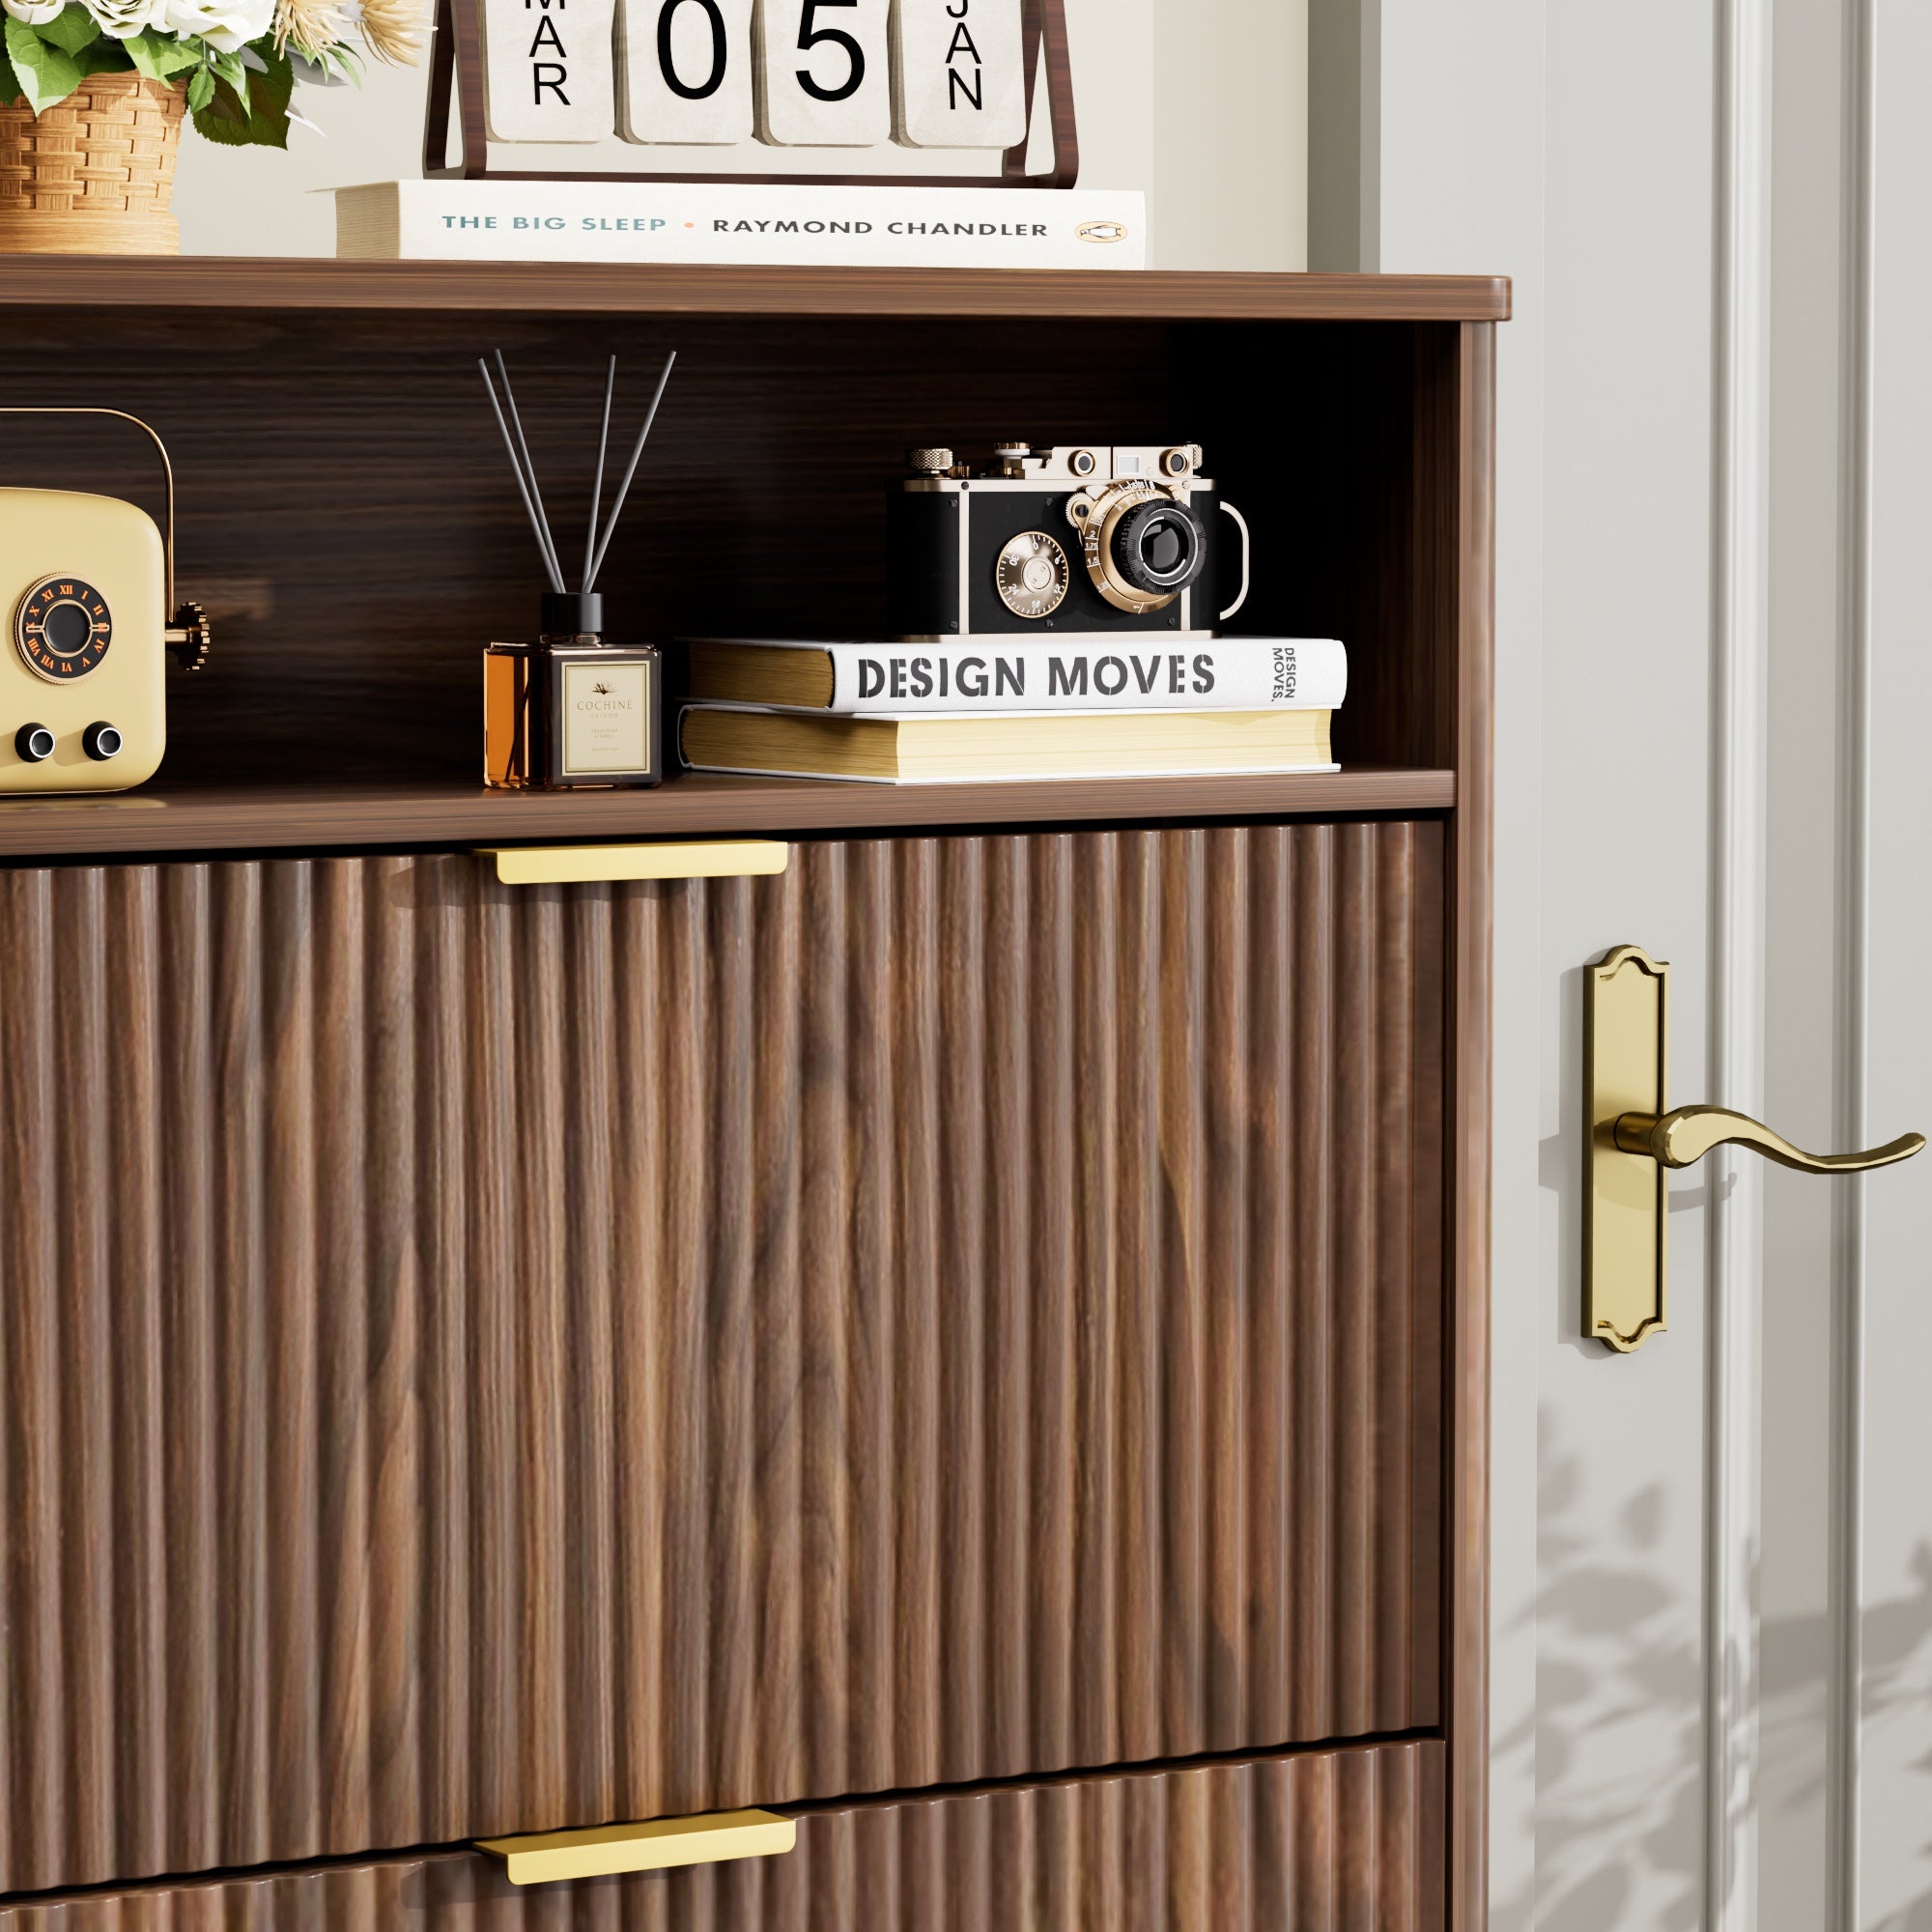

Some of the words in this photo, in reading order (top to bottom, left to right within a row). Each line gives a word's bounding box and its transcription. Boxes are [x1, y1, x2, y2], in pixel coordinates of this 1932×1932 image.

[525, 0, 571, 105] AR
[795, 0, 866, 102] 5
[441, 215, 497, 229] THE
[513, 216, 566, 230] BIG
[582, 217, 667, 231] SLEEP
[713, 219, 872, 234] RAYMOND
[887, 222, 1048, 237] CHANDLER
[42, 589, 54, 602] XI
[60, 584, 73, 595] XII
[858, 657, 1025, 698] DESIGN
[1048, 654, 1215, 696] MOVES
[1284, 647, 1296, 698] DESIGN
[577, 700, 634, 711] COCHINE
